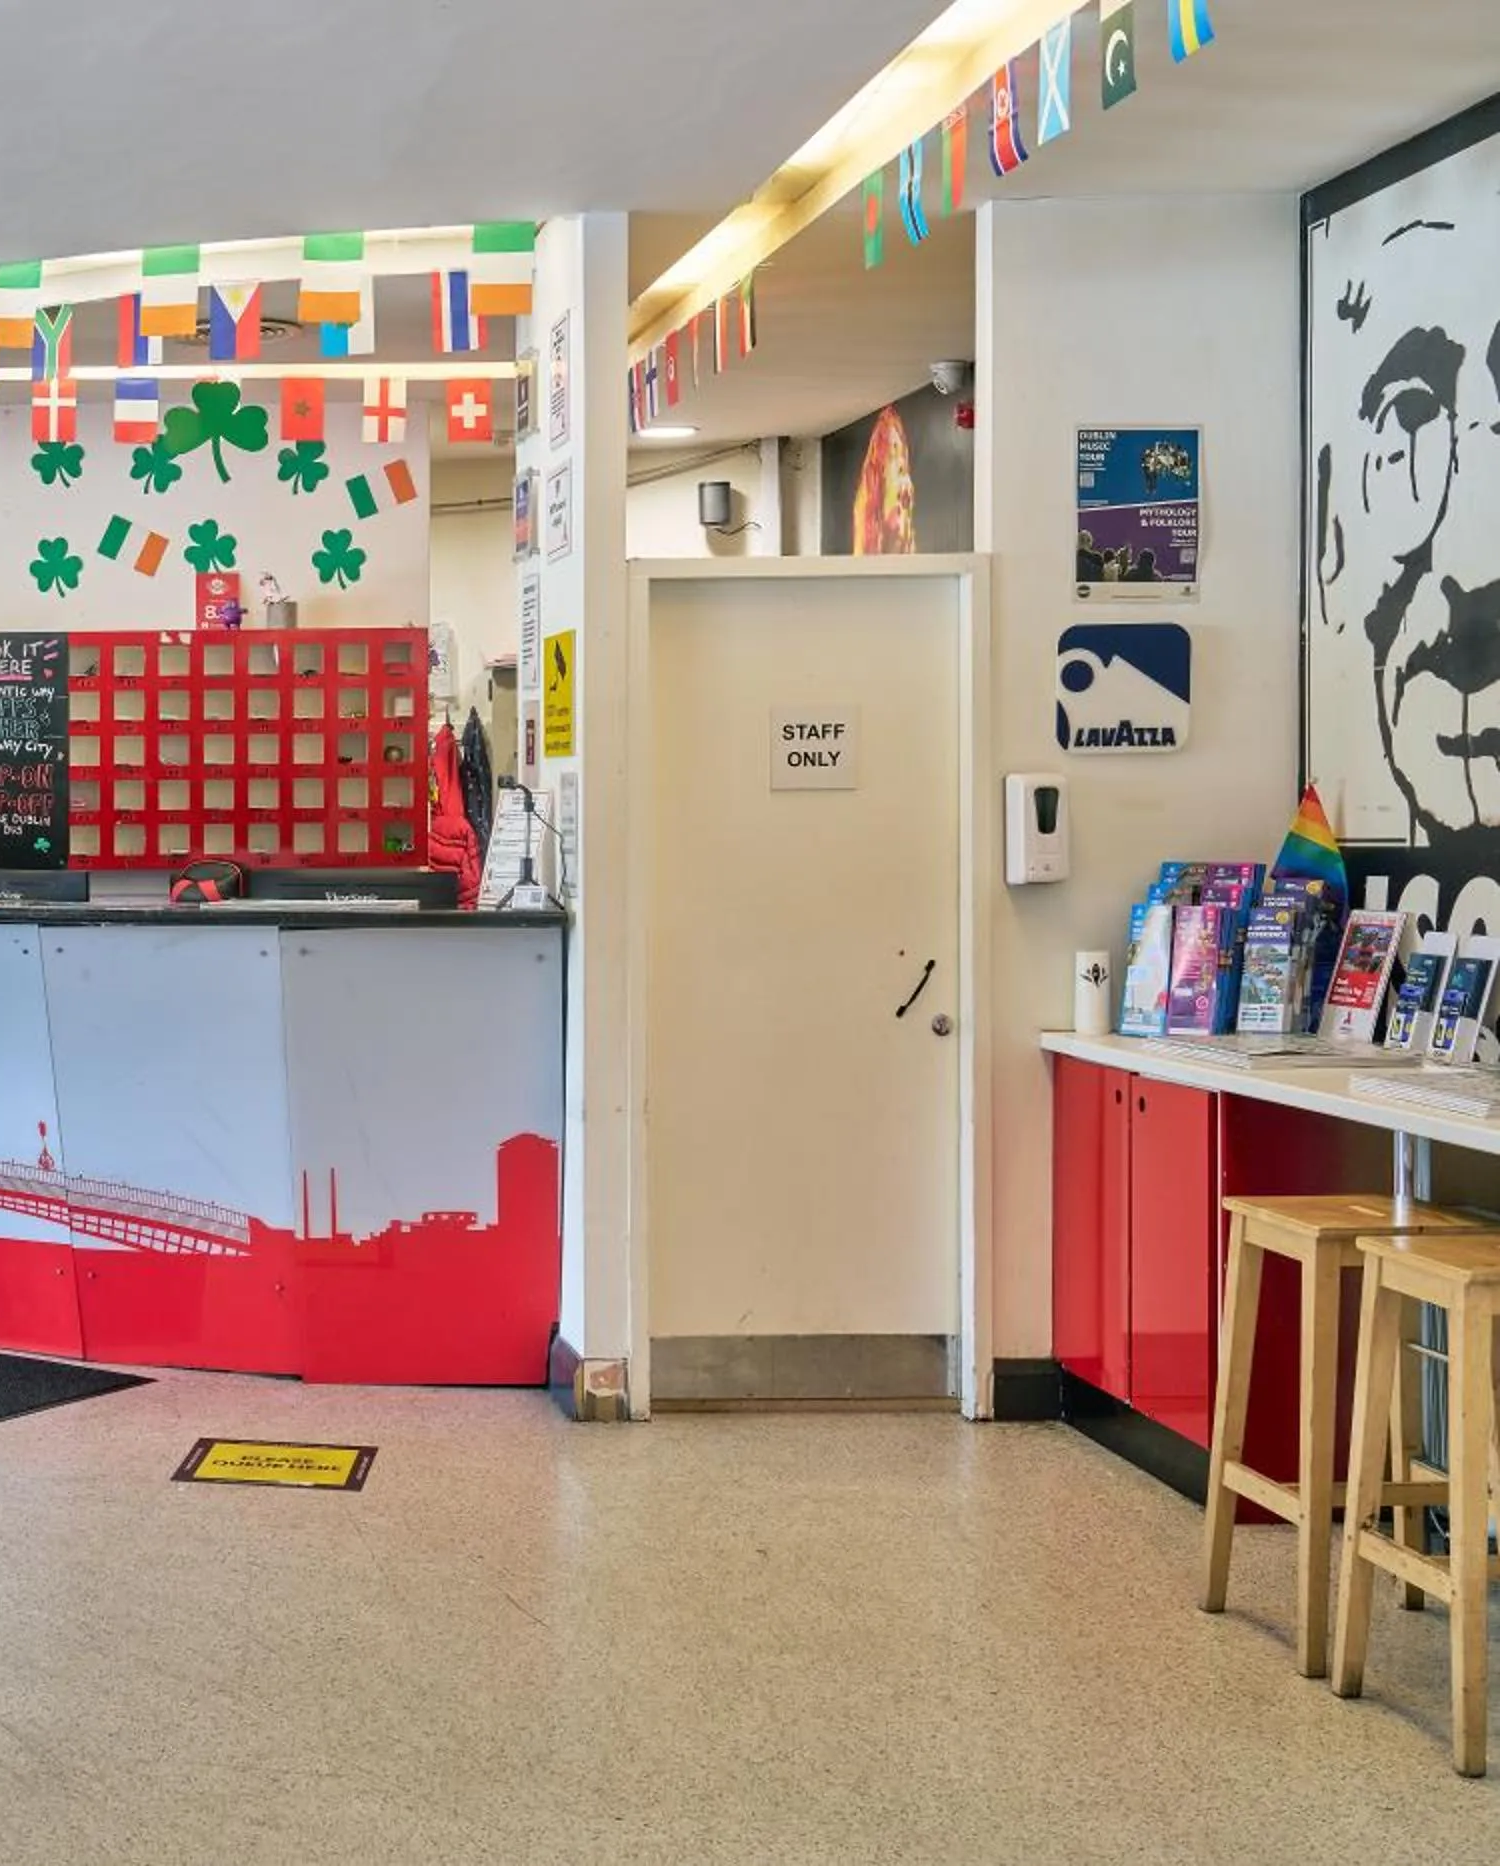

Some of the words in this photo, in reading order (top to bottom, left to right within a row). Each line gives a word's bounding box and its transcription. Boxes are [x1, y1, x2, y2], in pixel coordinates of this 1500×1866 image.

[1080, 442, 1111, 451] MUSIC
[1080, 453, 1105, 461] TOUR
[1139, 508, 1197, 517] MYTHOLOGY
[1149, 518, 1197, 527] FOLKLORE
[1171, 529, 1196, 537] TOUR
[22, 641, 44, 658] IT
[782, 723, 845, 740] STAFF
[1073, 719, 1177, 747] LAVAZZA
[25, 740, 53, 760] CITY
[787, 751, 841, 767] ONLY
[11, 814, 51, 827] DUBLIN
[212, 1459, 285, 1469] QUEUE
[288, 1463, 342, 1472] HERE
[240, 1455, 315, 1464] PLEASE
